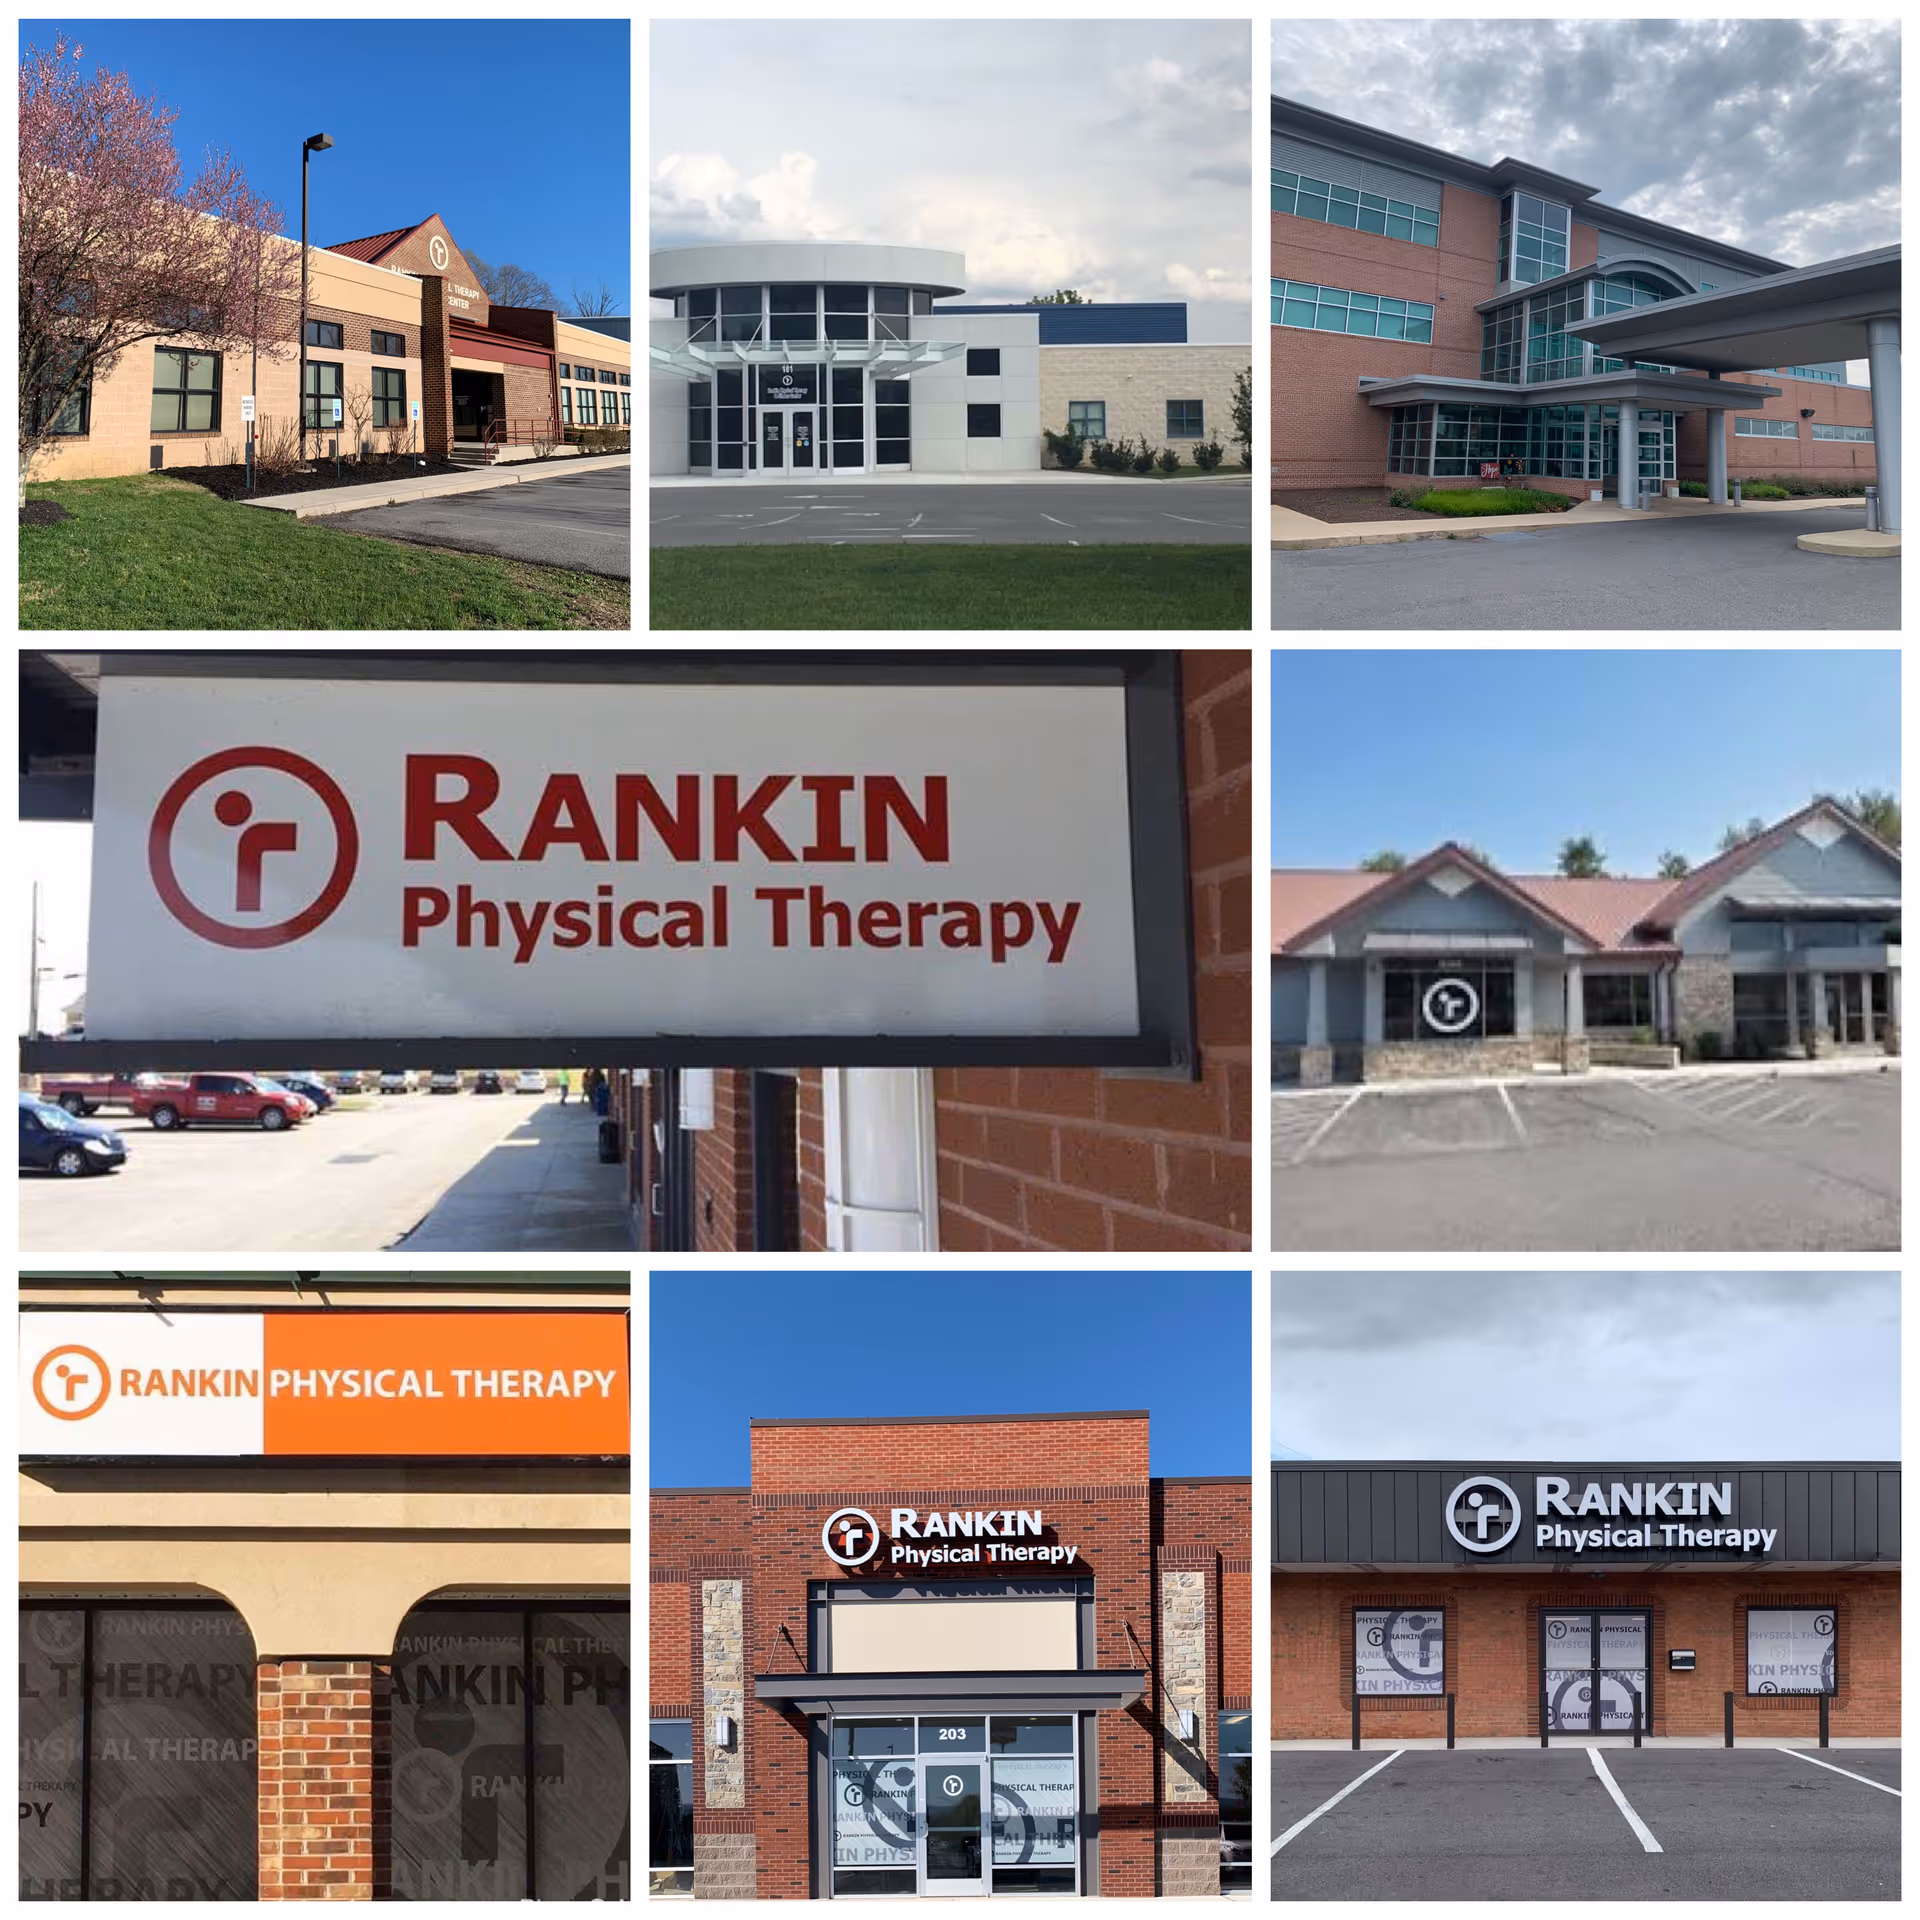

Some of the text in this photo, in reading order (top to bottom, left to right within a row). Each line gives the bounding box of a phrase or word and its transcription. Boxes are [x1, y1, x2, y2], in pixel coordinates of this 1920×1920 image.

[454, 284, 480, 300] THERAPY
[404, 754, 950, 862] RANKIN
[403, 885, 1081, 963] Physical Therapy
[120, 1368, 616, 1398] RANKIN PHYSICAL THERAPY
[1536, 1476, 1732, 1516] RANKIN
[891, 1508, 1042, 1539] RANKIN
[1536, 1524, 1777, 1552] Physical Therapy
[891, 1544, 1078, 1567] Physical Therapy
[938, 1728, 966, 1740] 203
[871, 1790, 907, 1798] RANKIN
